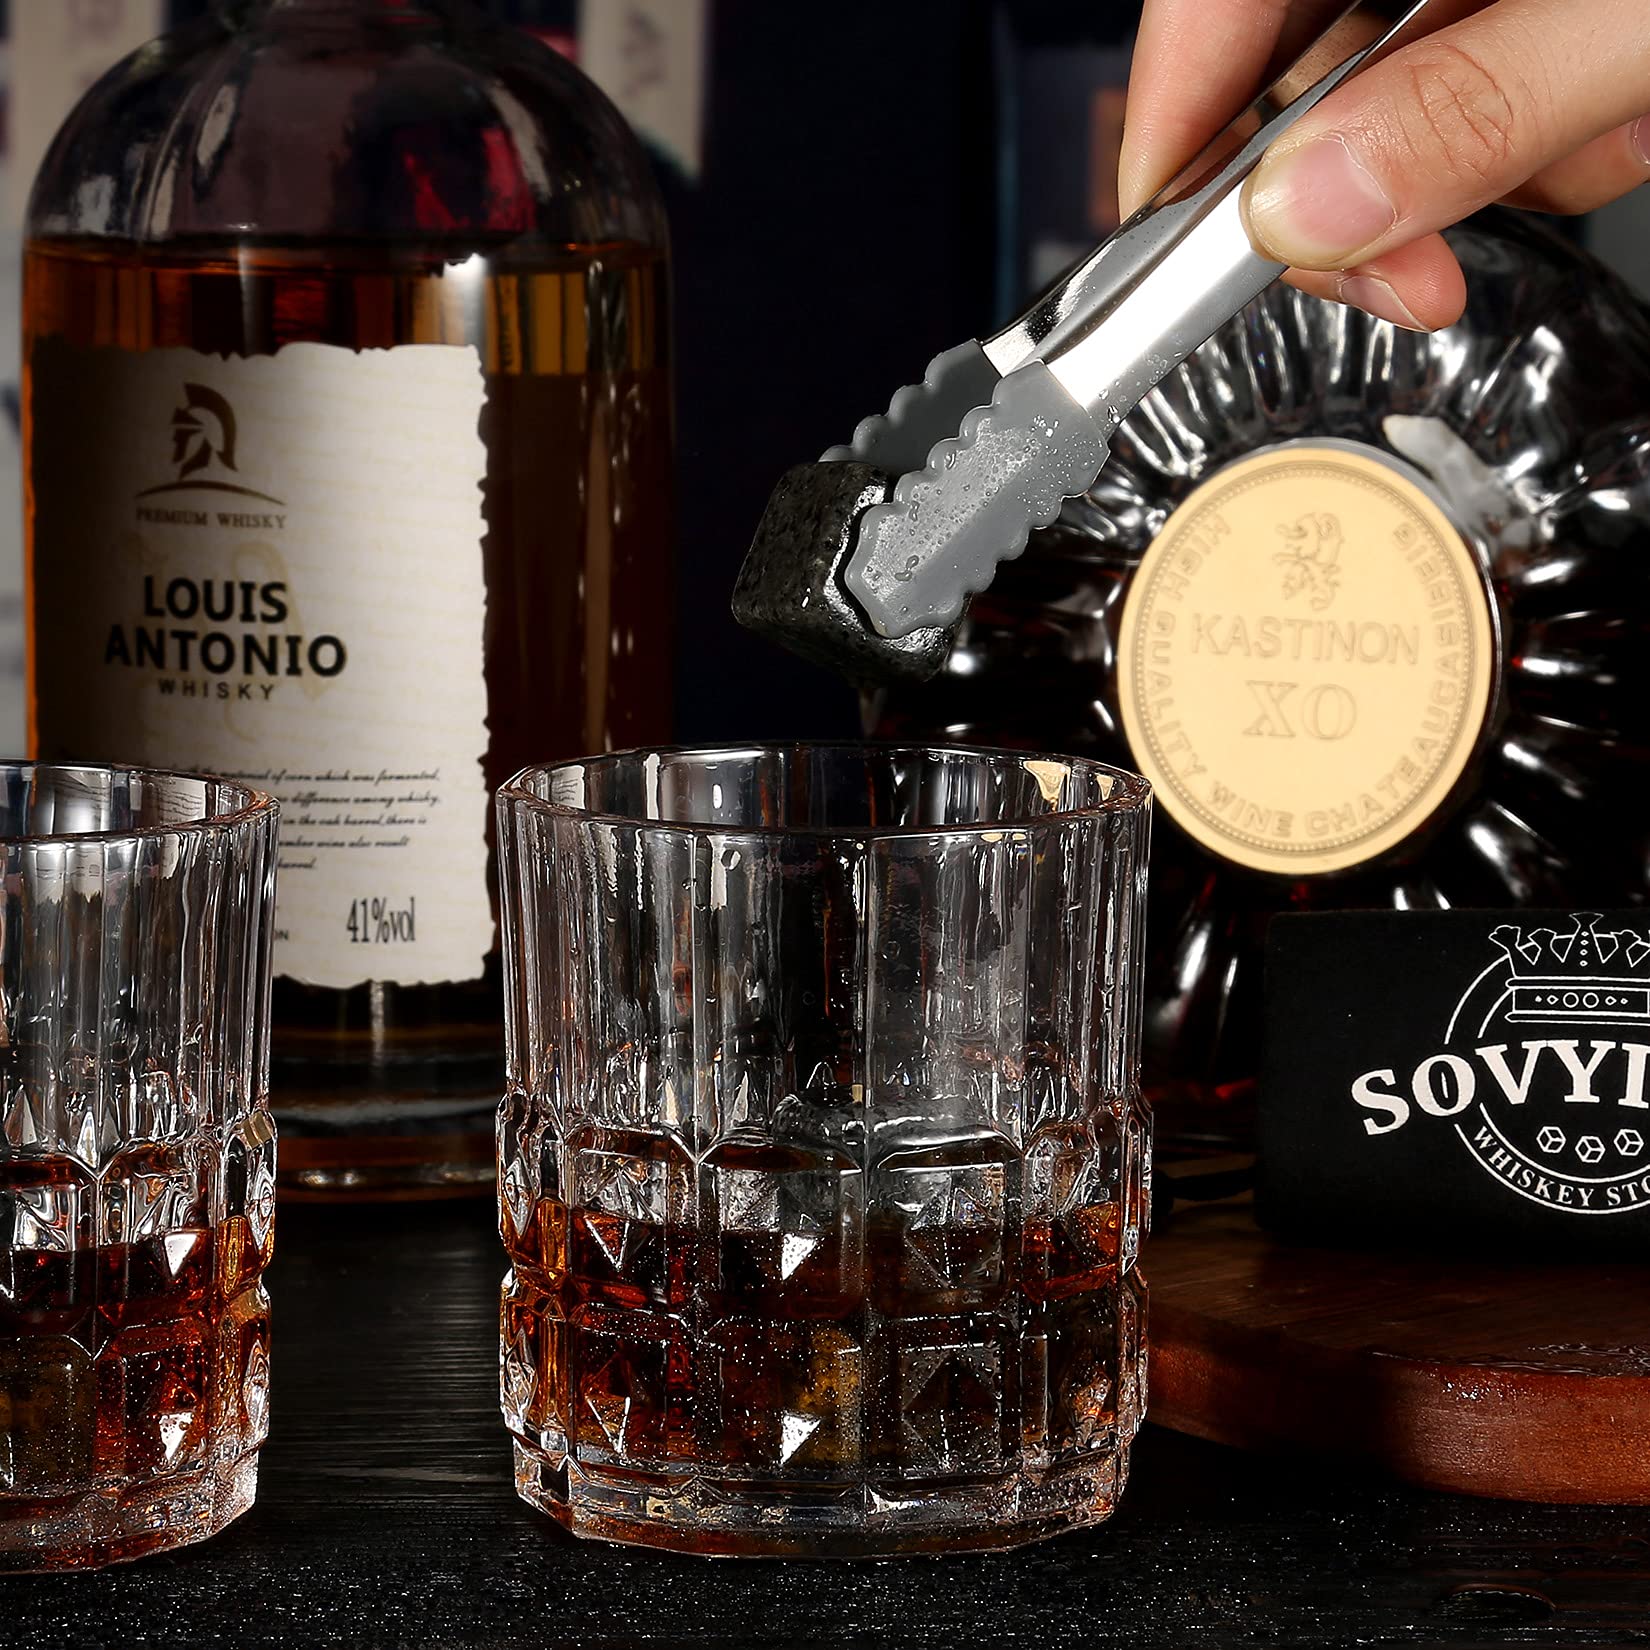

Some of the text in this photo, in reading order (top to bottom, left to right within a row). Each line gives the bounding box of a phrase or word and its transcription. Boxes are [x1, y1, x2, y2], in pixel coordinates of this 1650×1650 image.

[136, 507, 287, 529] PREMIUM WHISKY
[1157, 511, 1233, 602] HIGH
[143, 574, 288, 625] LOUIS
[103, 624, 348, 679] ANTONIO
[1190, 612, 1421, 666] KASTINON
[158, 678, 275, 700] WHISKY
[1147, 609, 1208, 780] QUALITY
[1241, 679, 1358, 742] XO
[1208, 779, 1295, 839] WINE
[347, 896, 416, 944] 41%vol
[1474, 1126, 1596, 1208] WHISKEY
